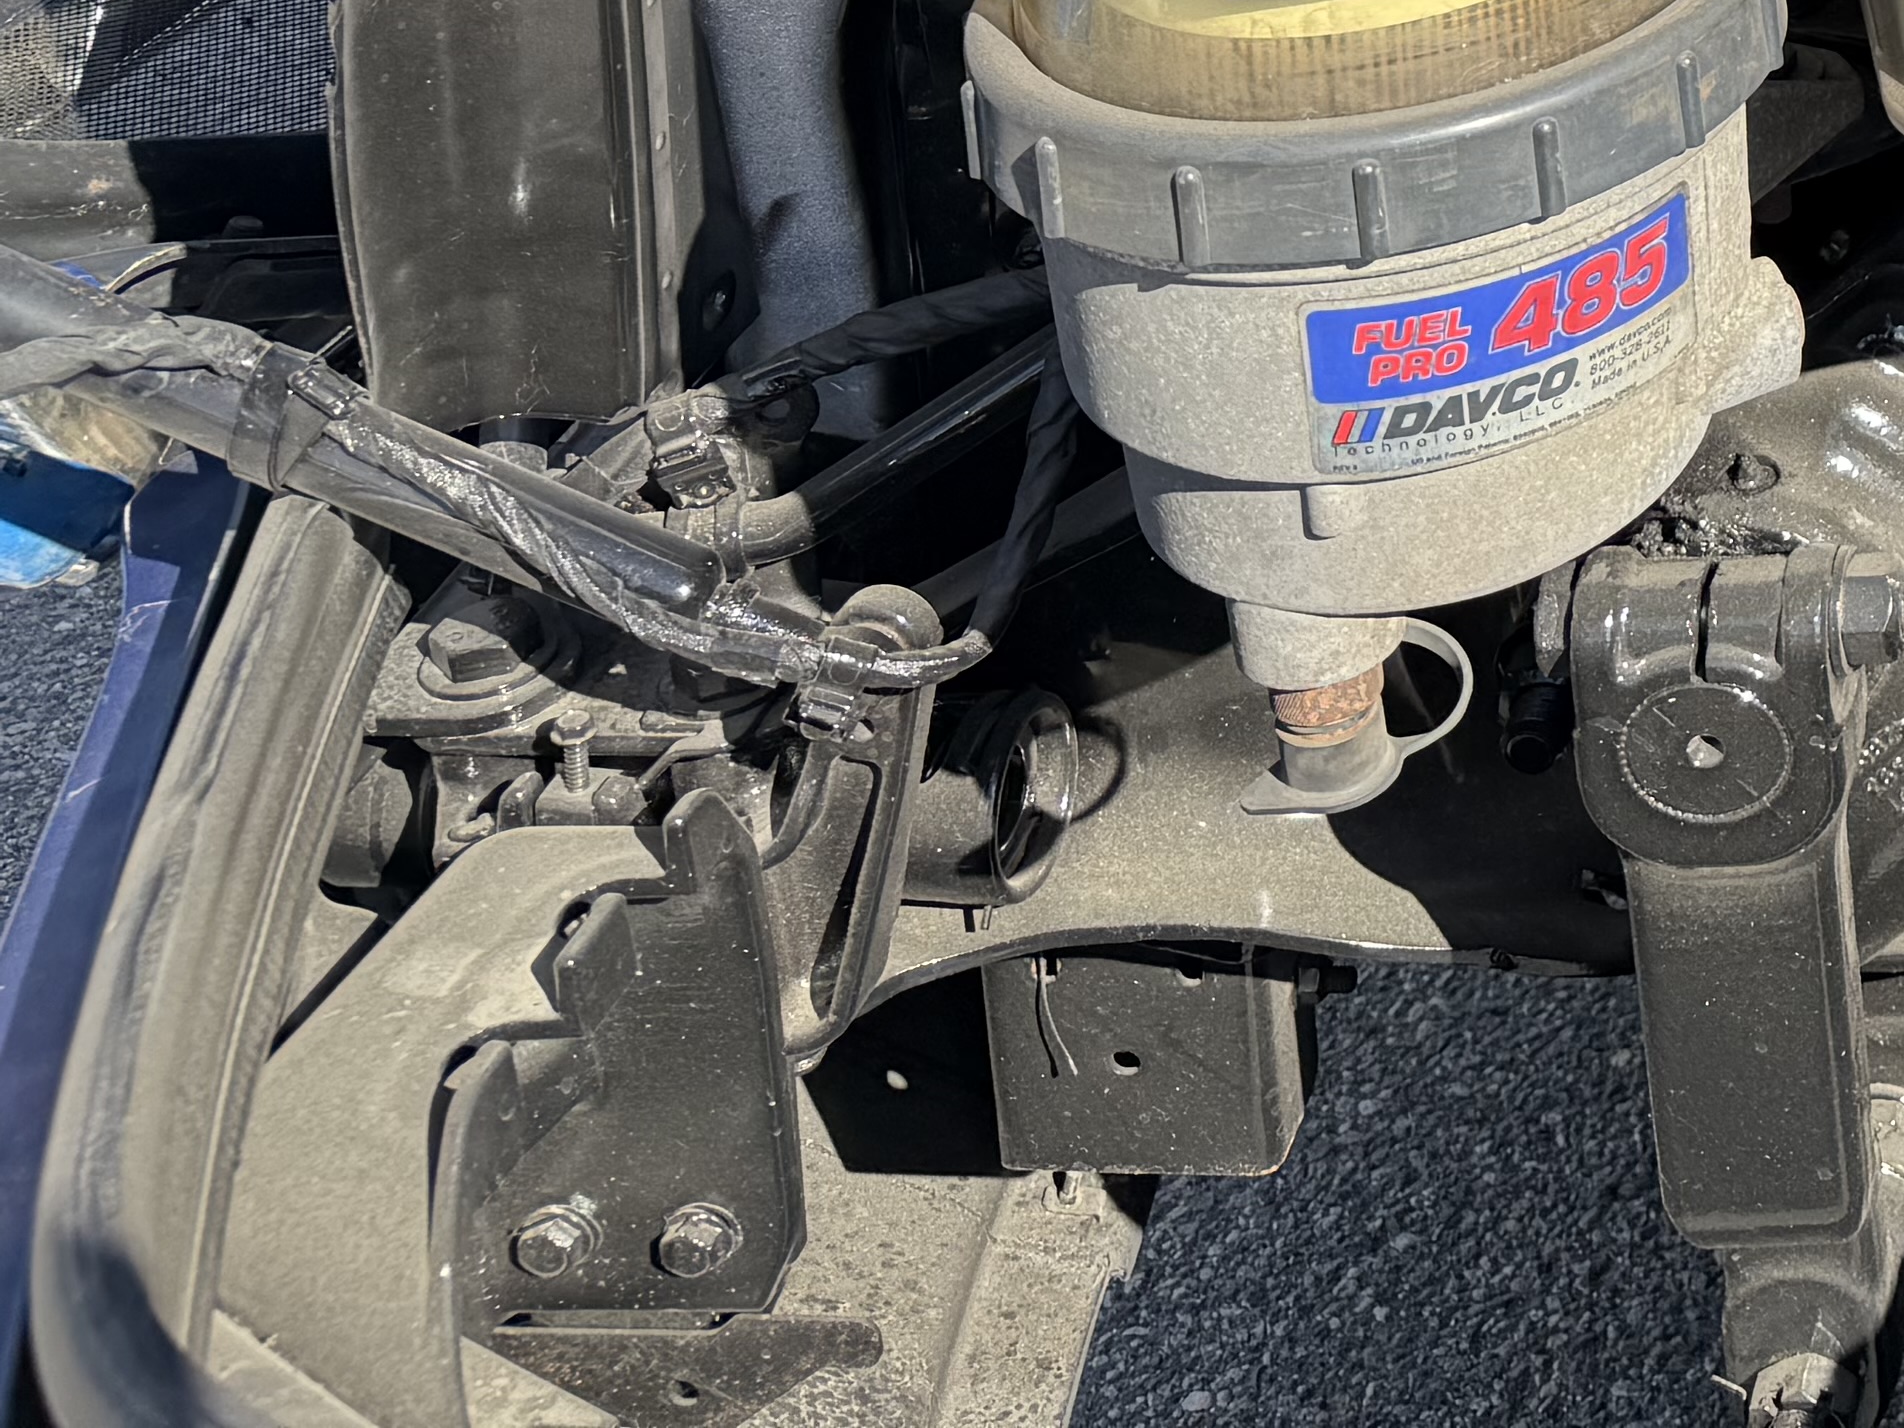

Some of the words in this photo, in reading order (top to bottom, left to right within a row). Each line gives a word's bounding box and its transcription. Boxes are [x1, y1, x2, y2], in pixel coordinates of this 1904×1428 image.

[1488, 213, 1671, 356] 485
[1352, 306, 1472, 356] FUEL
[1367, 340, 1470, 388] PRO
[1591, 366, 1622, 390] Made
[1627, 355, 1638, 370] in
